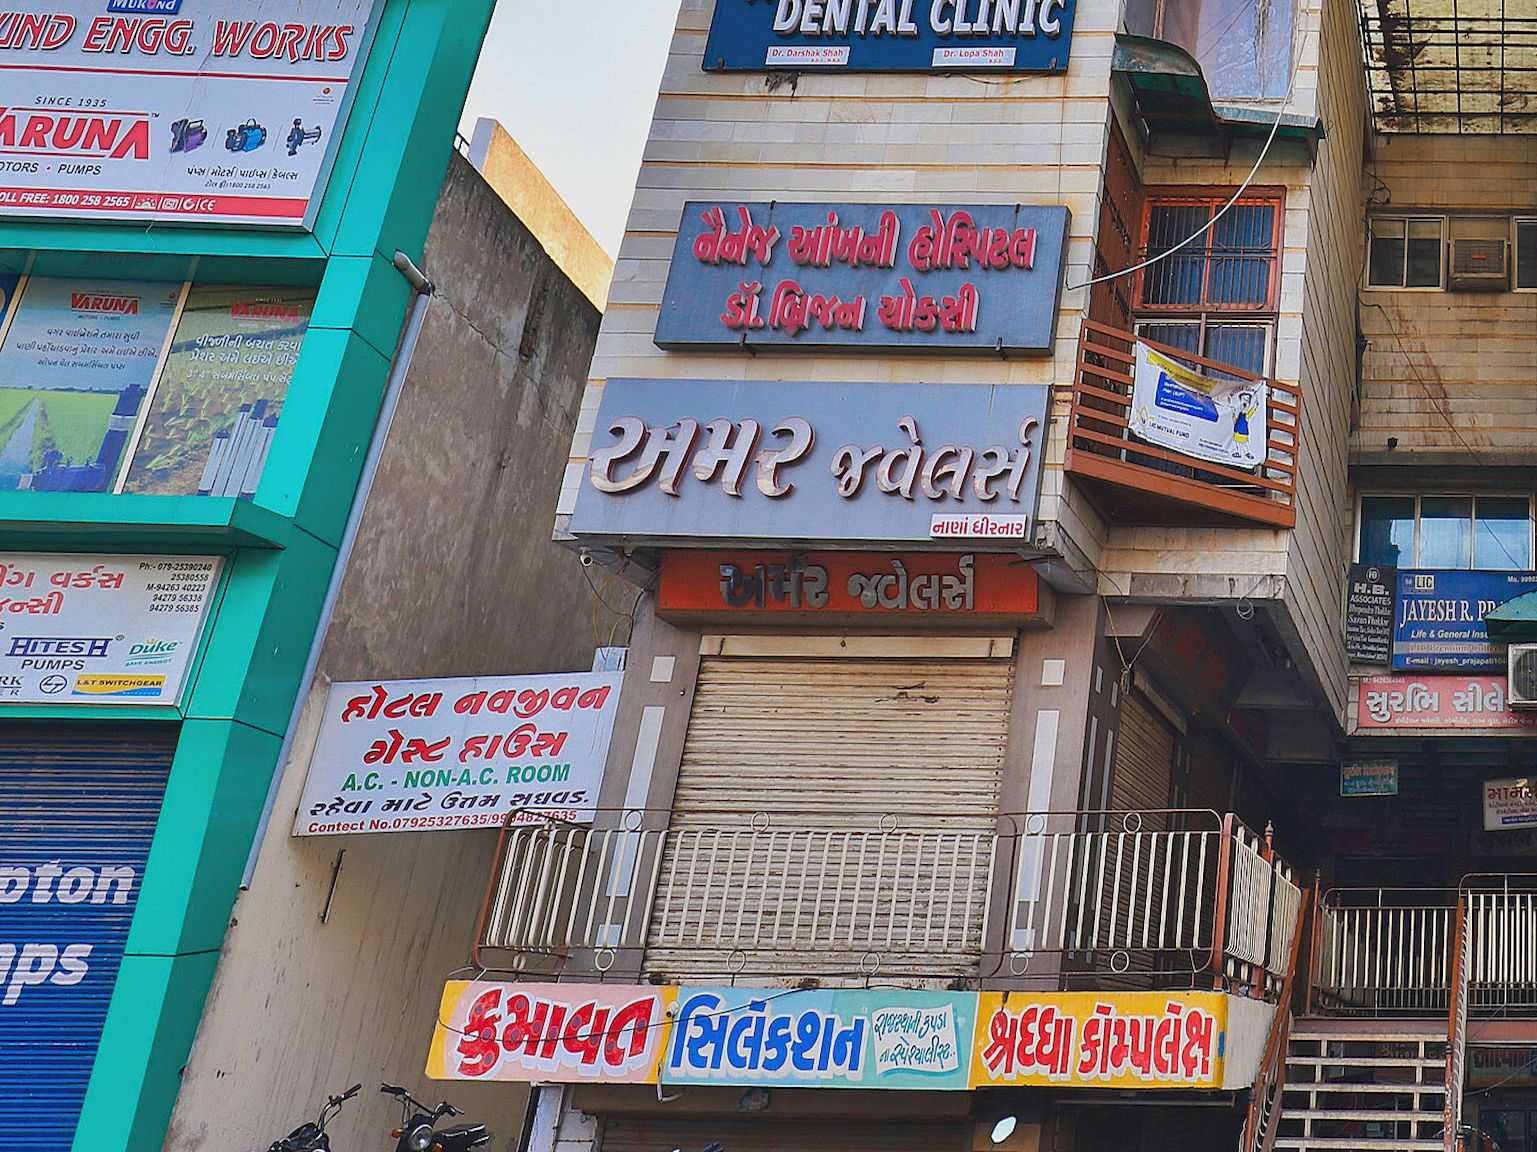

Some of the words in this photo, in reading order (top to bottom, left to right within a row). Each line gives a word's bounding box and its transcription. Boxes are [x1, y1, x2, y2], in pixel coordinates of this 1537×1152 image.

[82, 16, 195, 54] ENGG.
[212, 20, 353, 63] WORKS
[822, 49, 844, 57] Shah
[982, 49, 1004, 58] Shah
[34, 95, 73, 107] SINCE
[77, 98, 108, 108] 1935
[57, 163, 102, 176] PUMPS
[19, 191, 49, 205] FREE:
[52, 193, 79, 206] 1800
[80, 195, 102, 207] 258
[104, 195, 130, 208] 2565
[787, 210, 899, 270] આંખની
[71, 293, 139, 316] VARUNA
[588, 415, 815, 501] અમર
[1353, 581, 1390, 596] H.B.
[1400, 599, 1457, 628] JAYESH
[1438, 629, 1471, 639] General
[5, 636, 114, 657] HITESH
[21, 658, 86, 671] PUMPS
[341, 685, 443, 723] હોટલ
[453, 685, 611, 719] નવજીવન
[458, 723, 568, 763] હાઉસ
[341, 773, 384, 792] A.C.
[403, 768, 499, 789] NON-A.C.
[506, 764, 571, 784] ROOM
[308, 820, 365, 834] Contect
